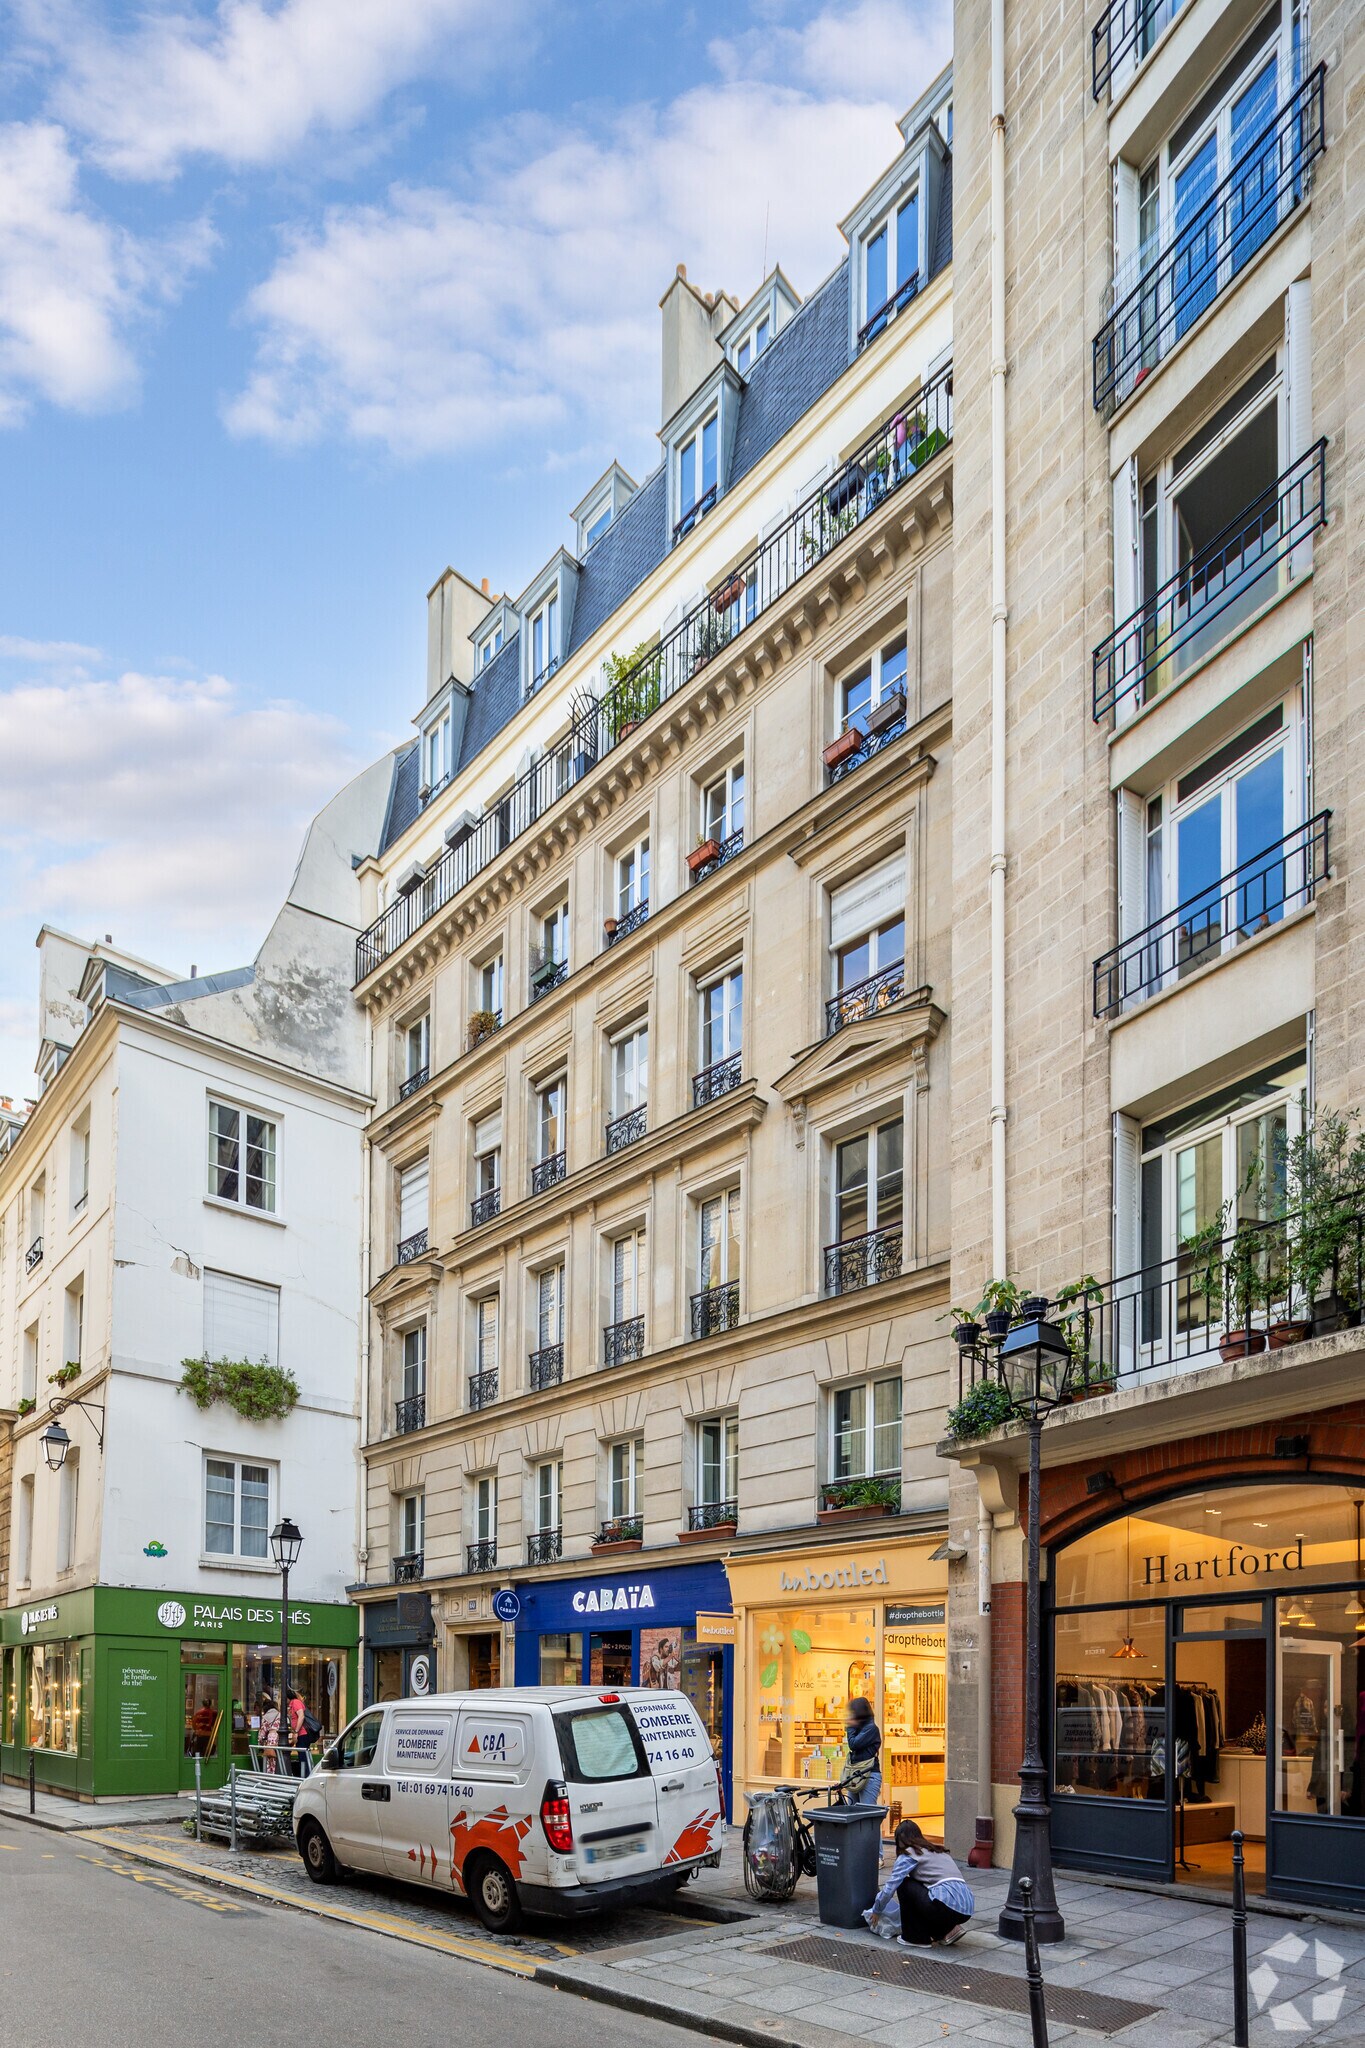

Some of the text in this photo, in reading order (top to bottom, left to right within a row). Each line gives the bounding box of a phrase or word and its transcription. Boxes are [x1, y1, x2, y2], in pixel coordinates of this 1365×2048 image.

[1142, 1539, 1305, 1585] Hartford
[780, 1558, 889, 1592] unbottled
[194, 1605, 311, 1625] PALAIS DES THÉS
[889, 1609, 944, 1621] #dropthebottle
[194, 1620, 223, 1628] PARIS
[634, 1703, 677, 1714] DEPANNAGE
[398, 1738, 438, 1750] PLOMBERIE
[483, 1733, 506, 1761] CBA
[396, 1750, 437, 1760] MAINTENANCE
[647, 1747, 695, 1763] 74 16 40
[424, 1784, 435, 1794] 69
[436, 1784, 447, 1795] 74
[450, 1785, 461, 1796] 16
[461, 1786, 474, 1797] 40
